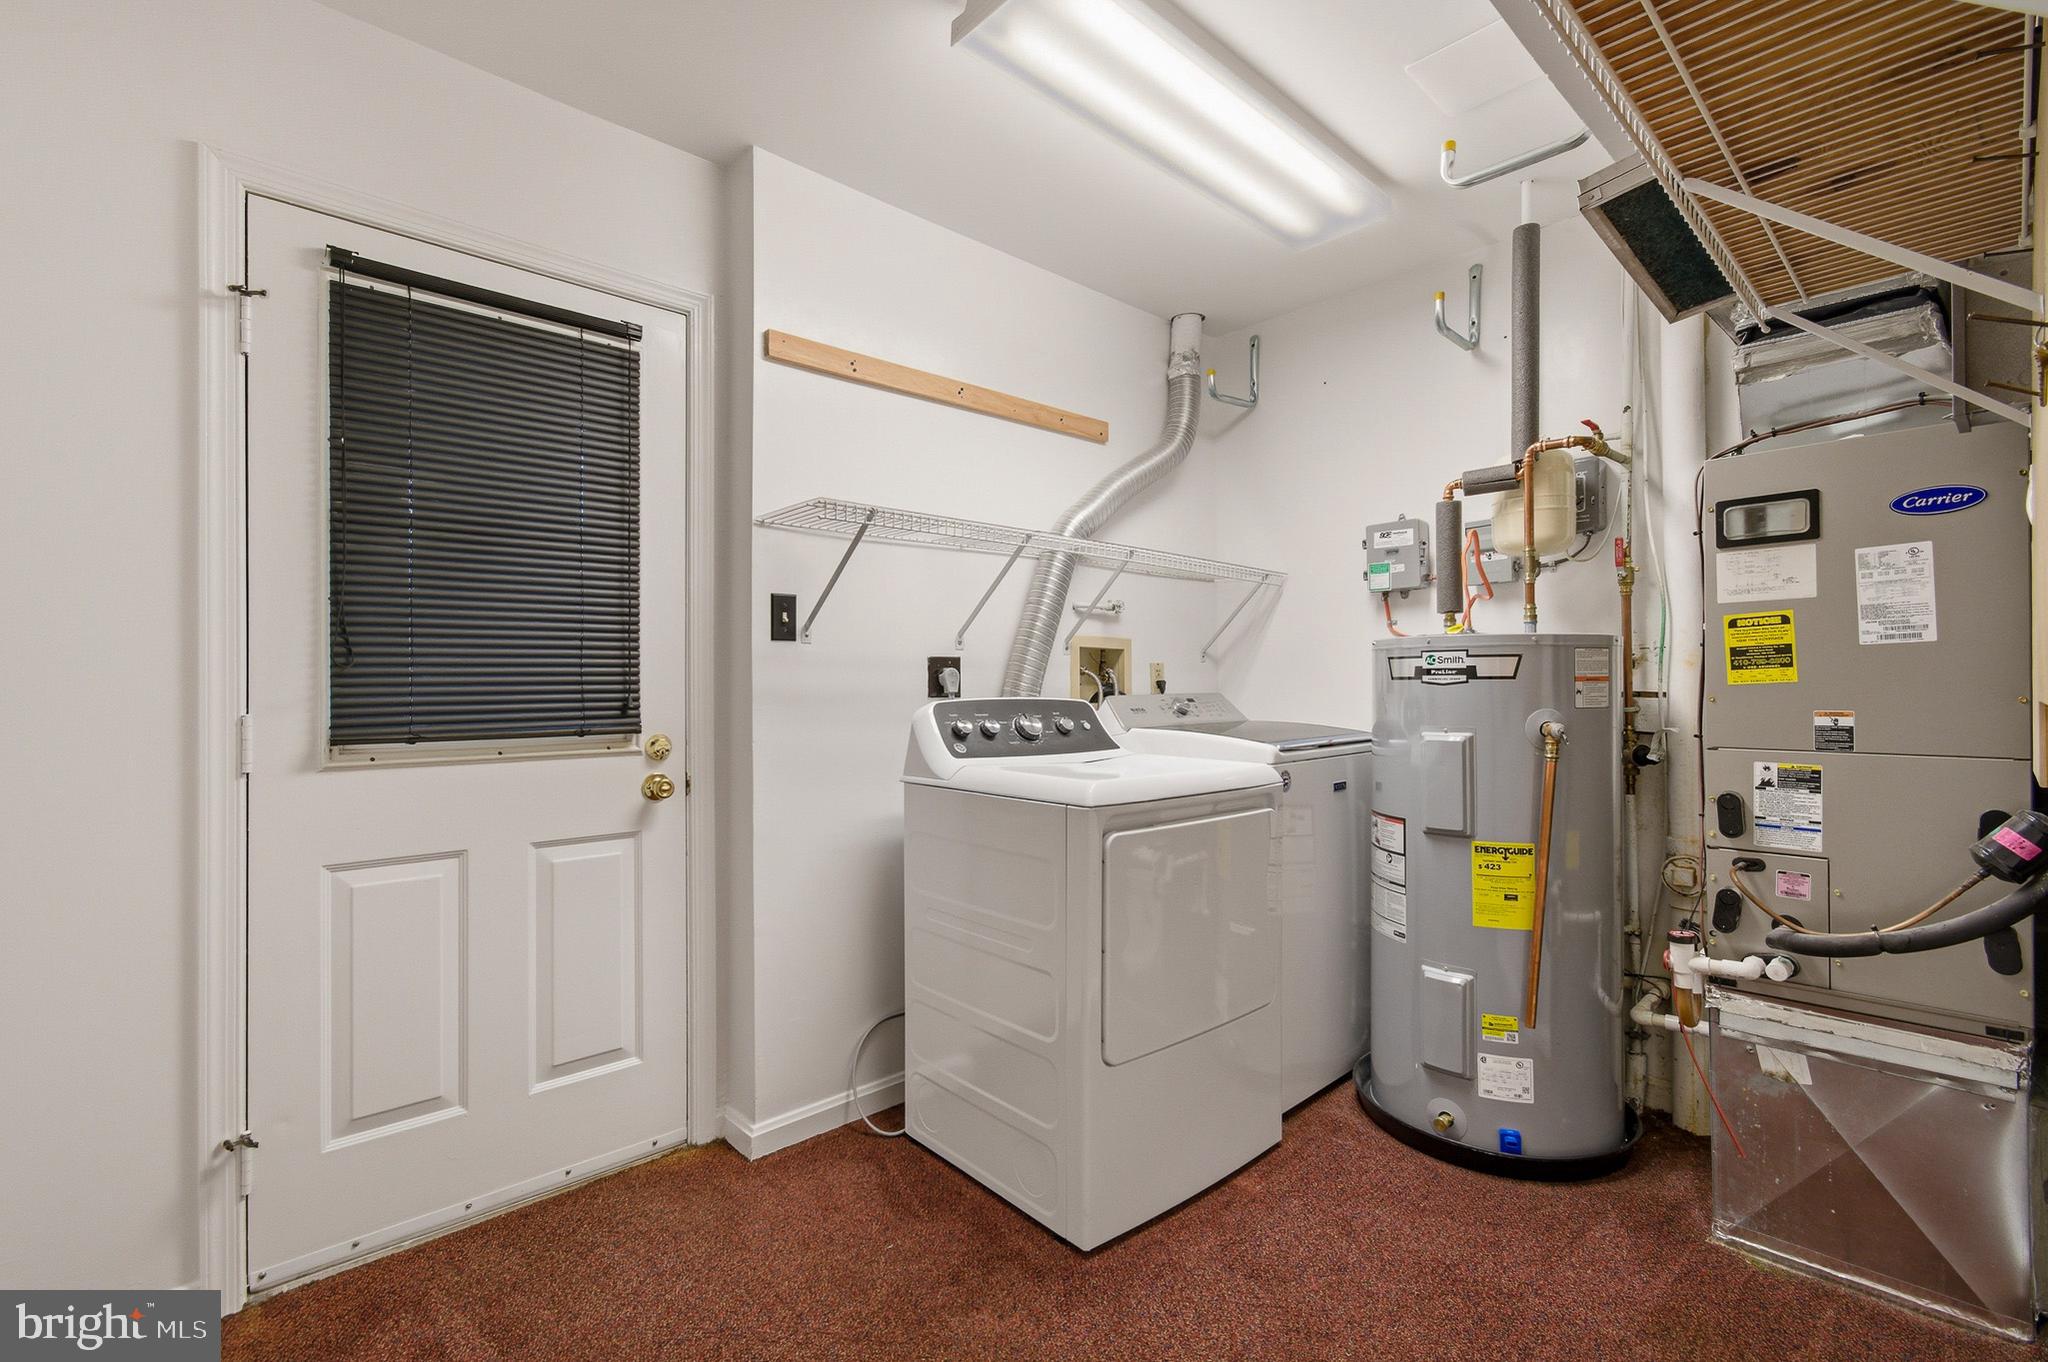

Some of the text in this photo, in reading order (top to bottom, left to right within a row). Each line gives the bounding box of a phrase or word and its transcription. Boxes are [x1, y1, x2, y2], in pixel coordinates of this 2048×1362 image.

[1902, 492, 1973, 509] Carrier
[1437, 655, 1465, 664] Smith
[1474, 845, 1534, 857] ENERGYGUIDE
